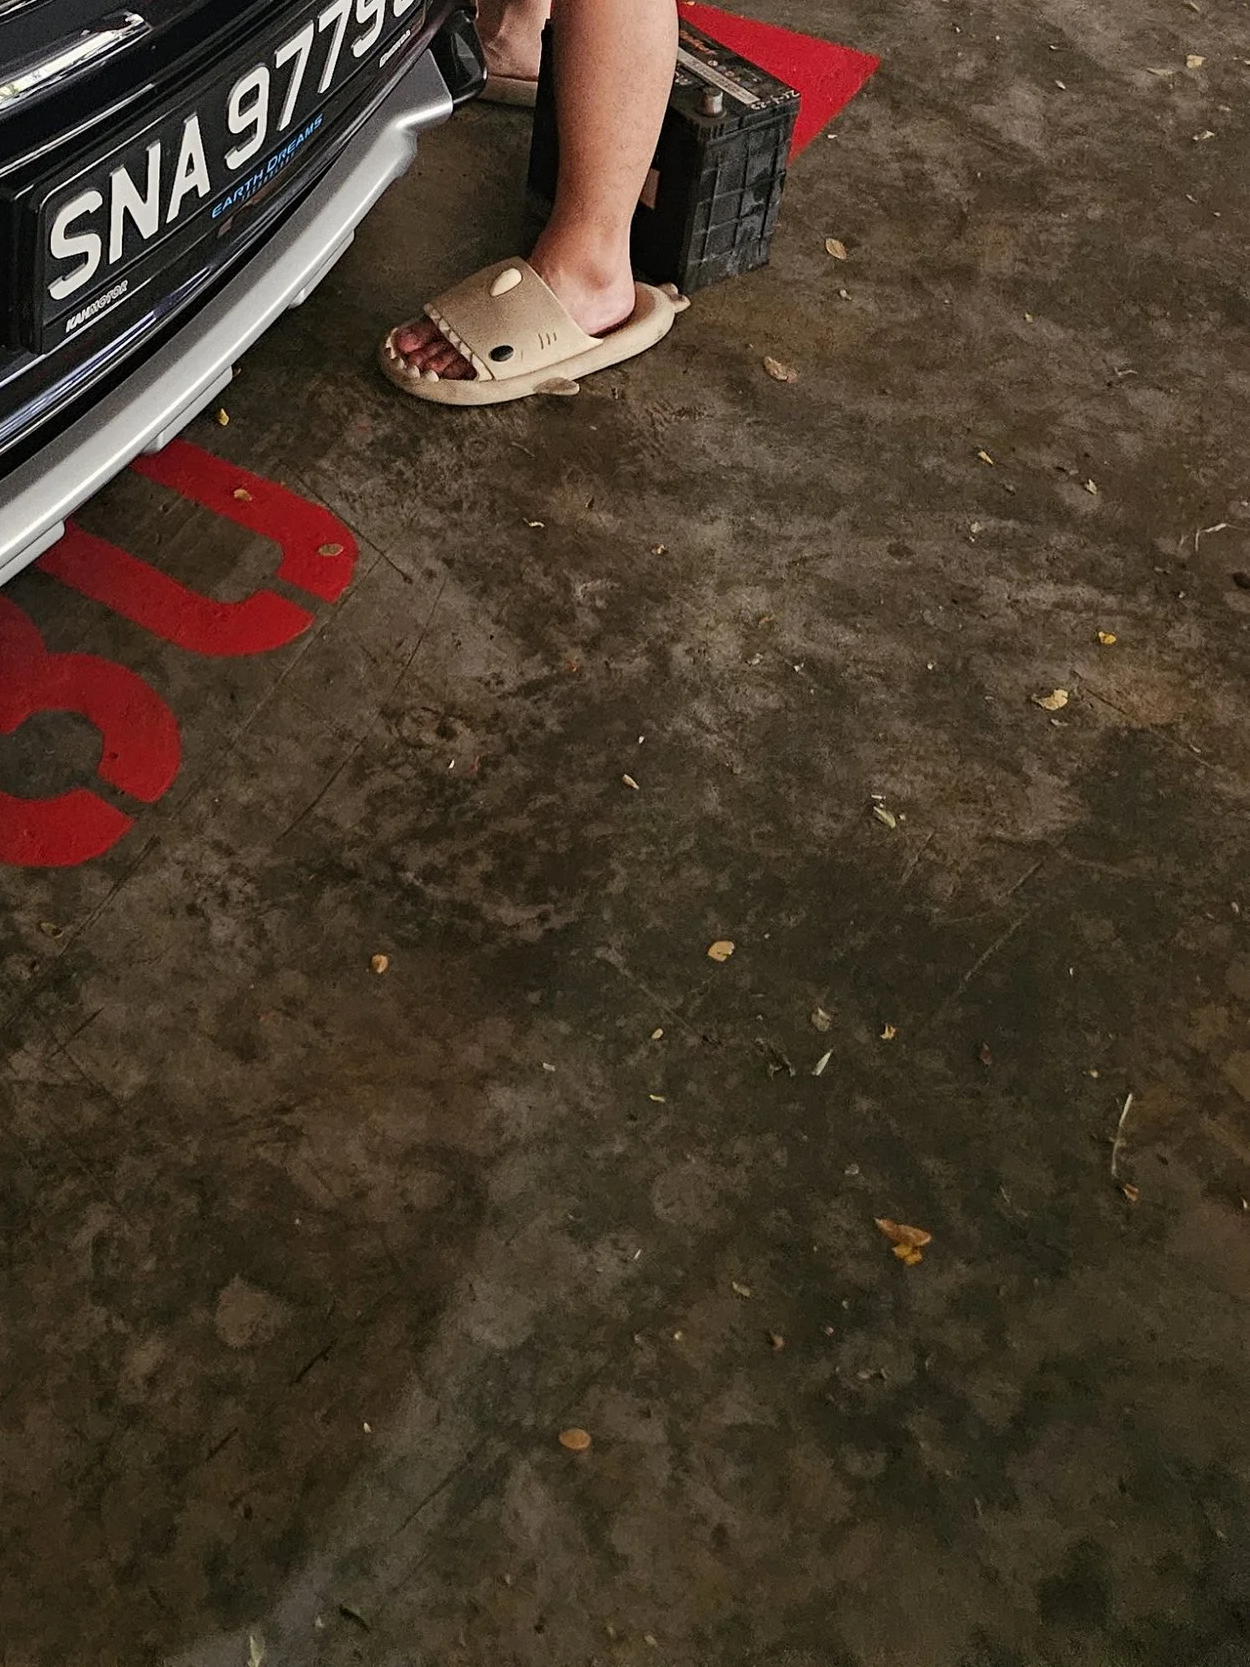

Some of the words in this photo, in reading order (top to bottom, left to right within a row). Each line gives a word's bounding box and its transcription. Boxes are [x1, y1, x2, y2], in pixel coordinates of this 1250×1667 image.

[48, 113, 211, 300] SNA
[211, 169, 264, 219] EARTH
[266, 113, 324, 173] DREAMS
